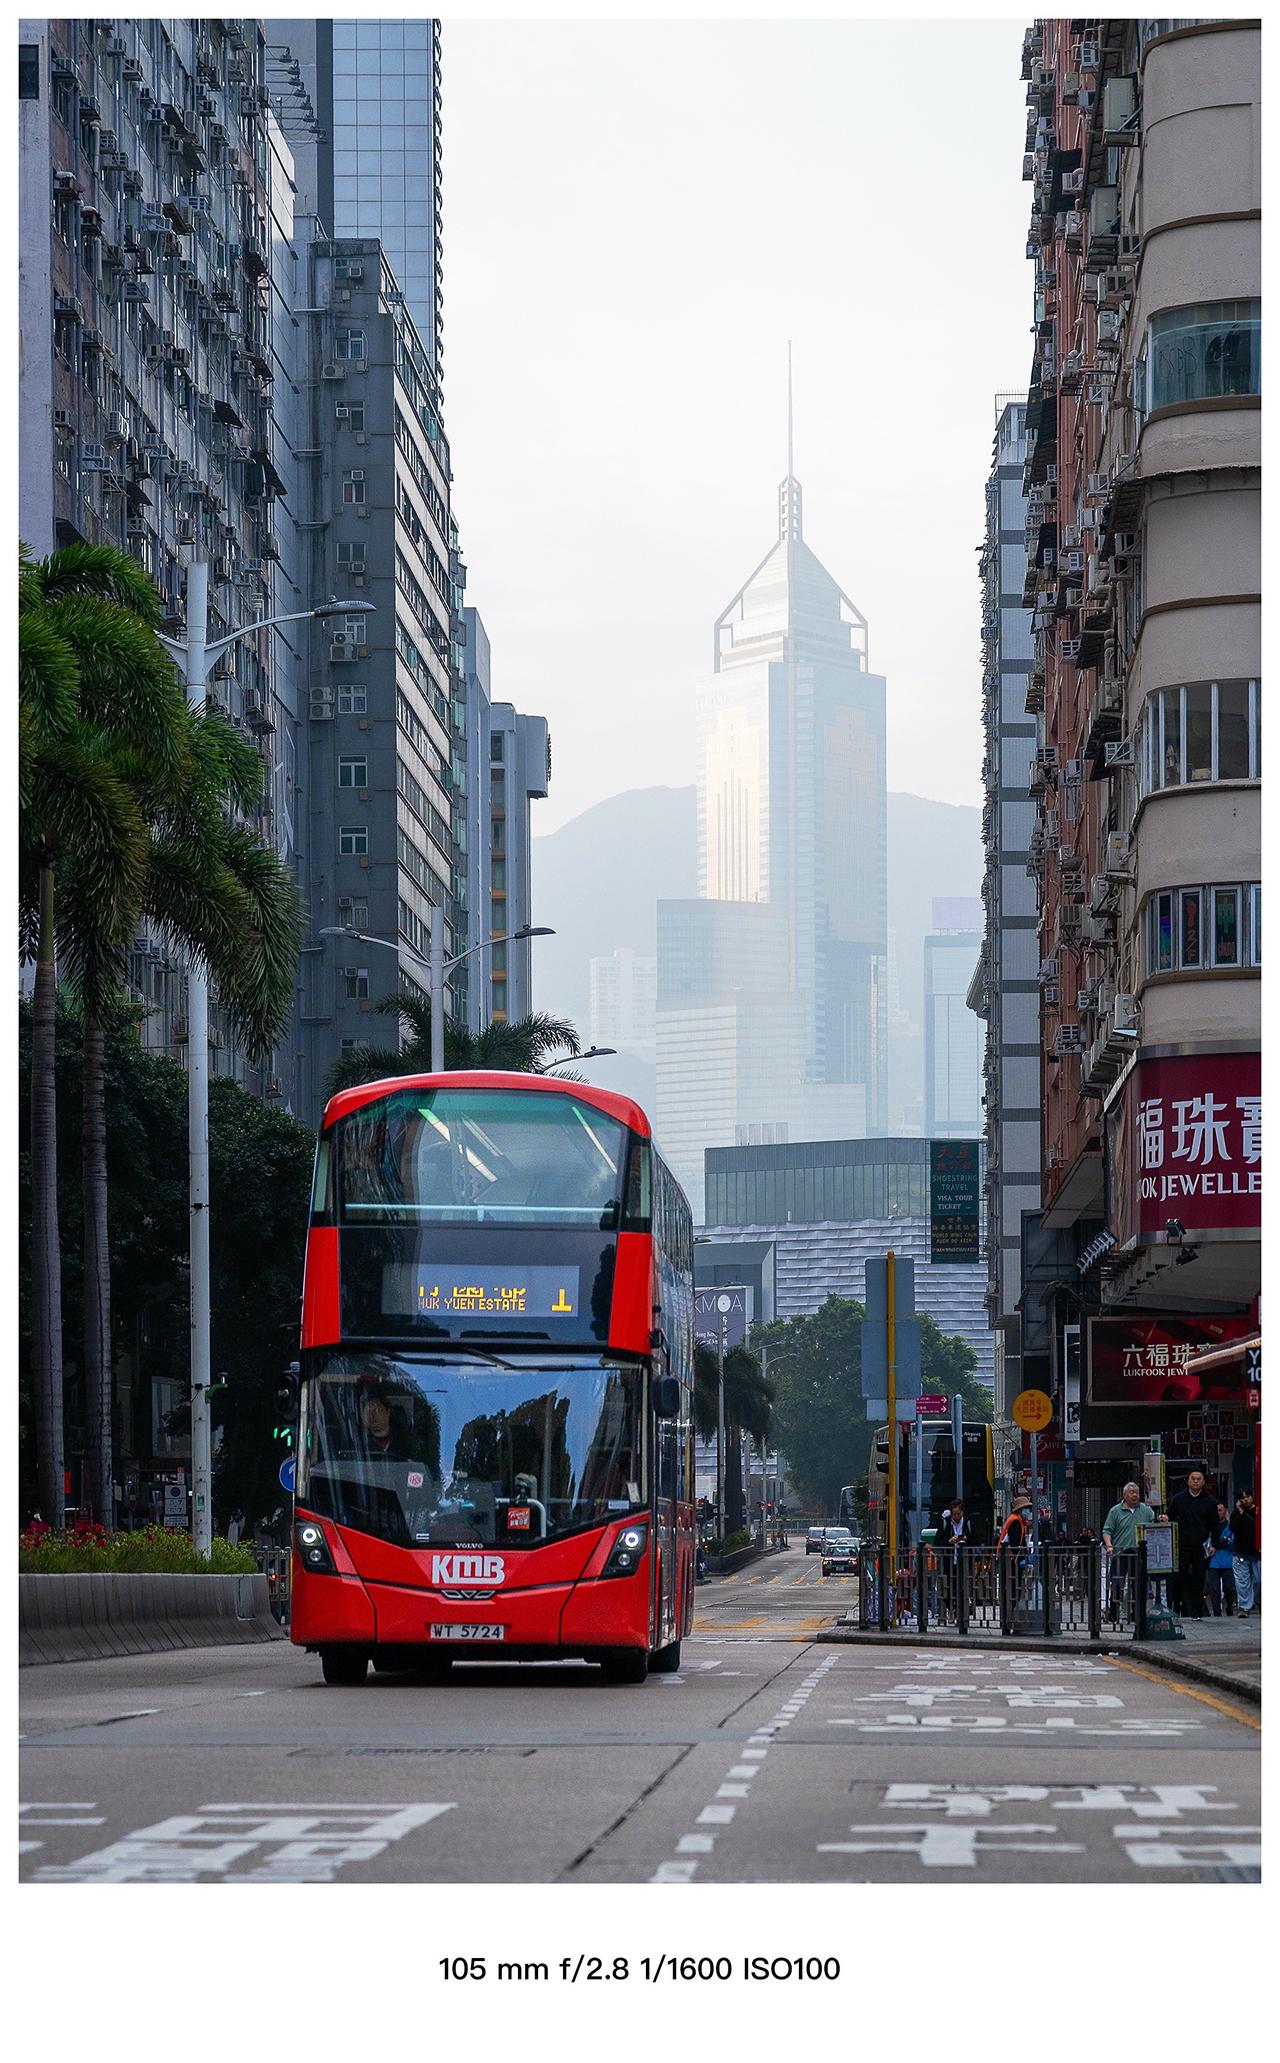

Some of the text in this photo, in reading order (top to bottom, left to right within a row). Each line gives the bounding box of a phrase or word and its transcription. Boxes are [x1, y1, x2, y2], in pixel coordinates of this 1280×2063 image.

[932, 1174, 978, 1184] SHOESTRING
[941, 1183, 969, 1191] TRAVEL
[1160, 1172, 1261, 1202] JEWELLE
[444, 1298, 475, 1310] YUEN
[478, 1298, 526, 1311] ESTATE
[1123, 1368, 1165, 1377] LUKFOOK
[432, 1555, 506, 1584] KMB
[434, 1625, 501, 1638] WT 5724
